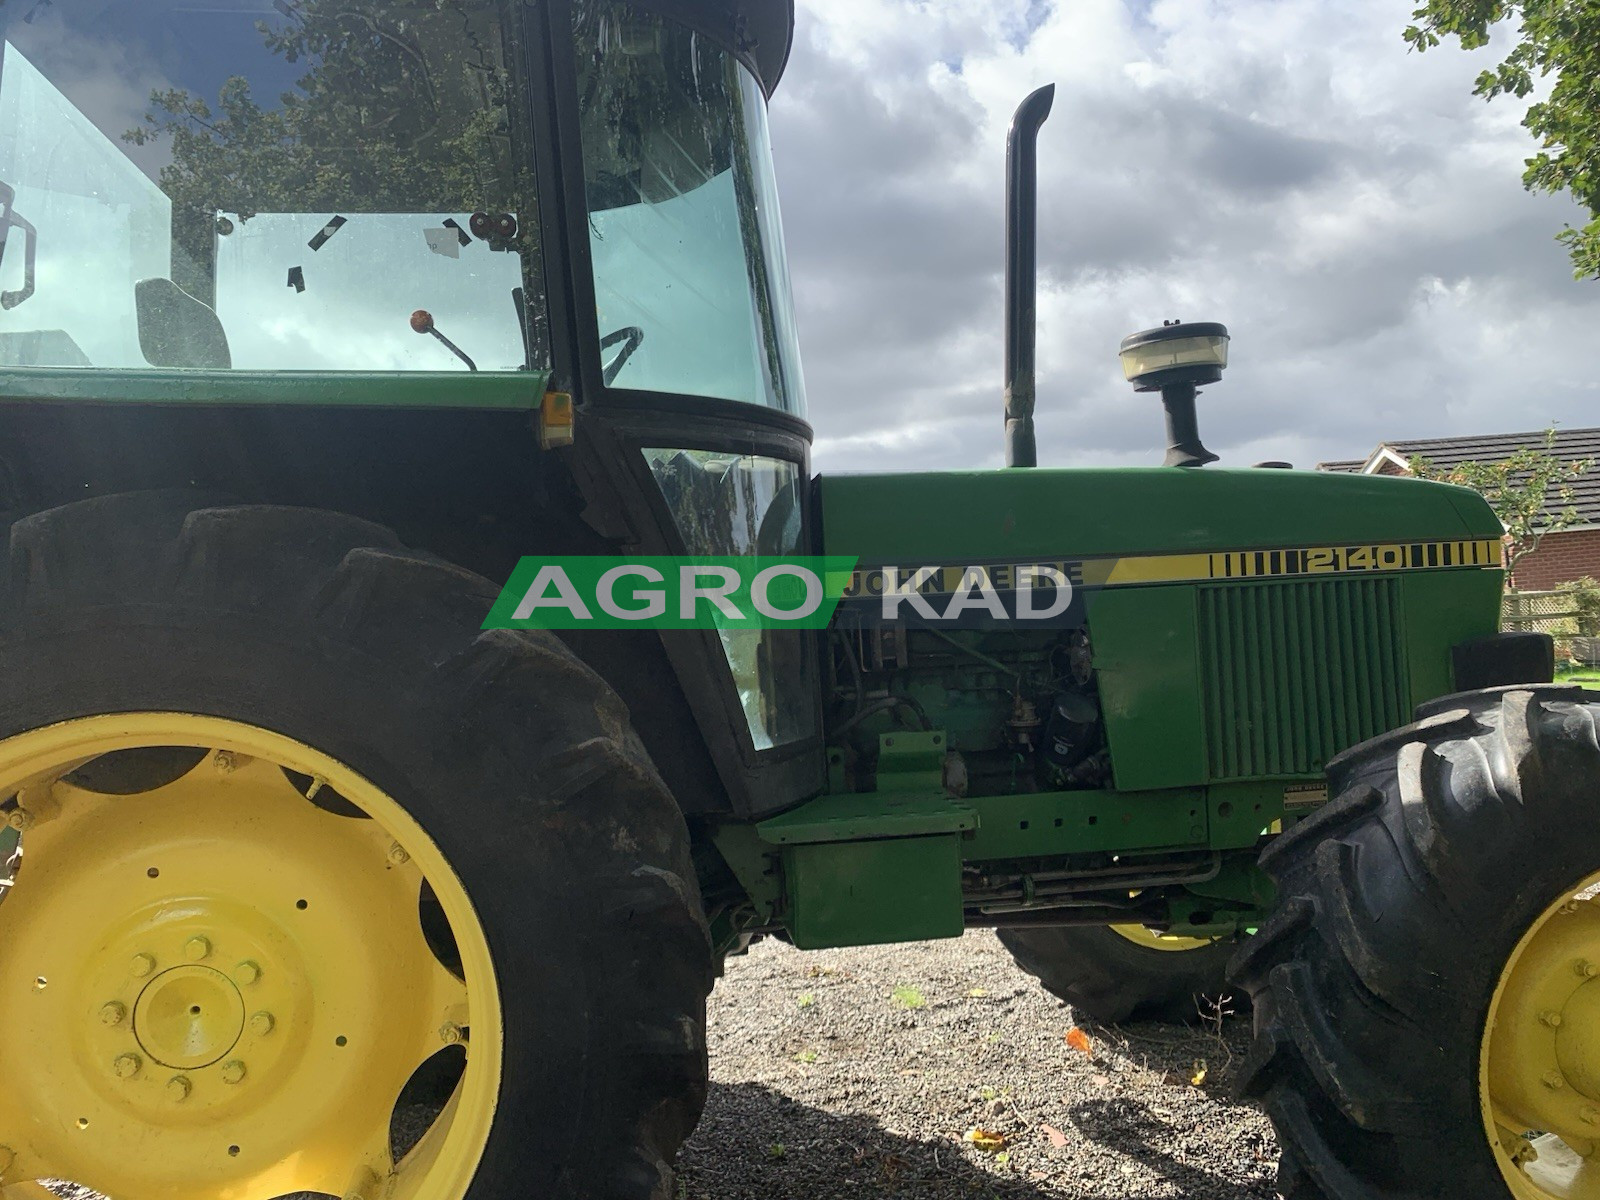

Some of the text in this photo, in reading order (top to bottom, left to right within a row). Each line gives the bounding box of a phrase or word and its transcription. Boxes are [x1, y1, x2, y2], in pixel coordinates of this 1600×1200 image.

[1307, 545, 1402, 573] 2140
[843, 561, 1084, 597] JOHN DEERE
